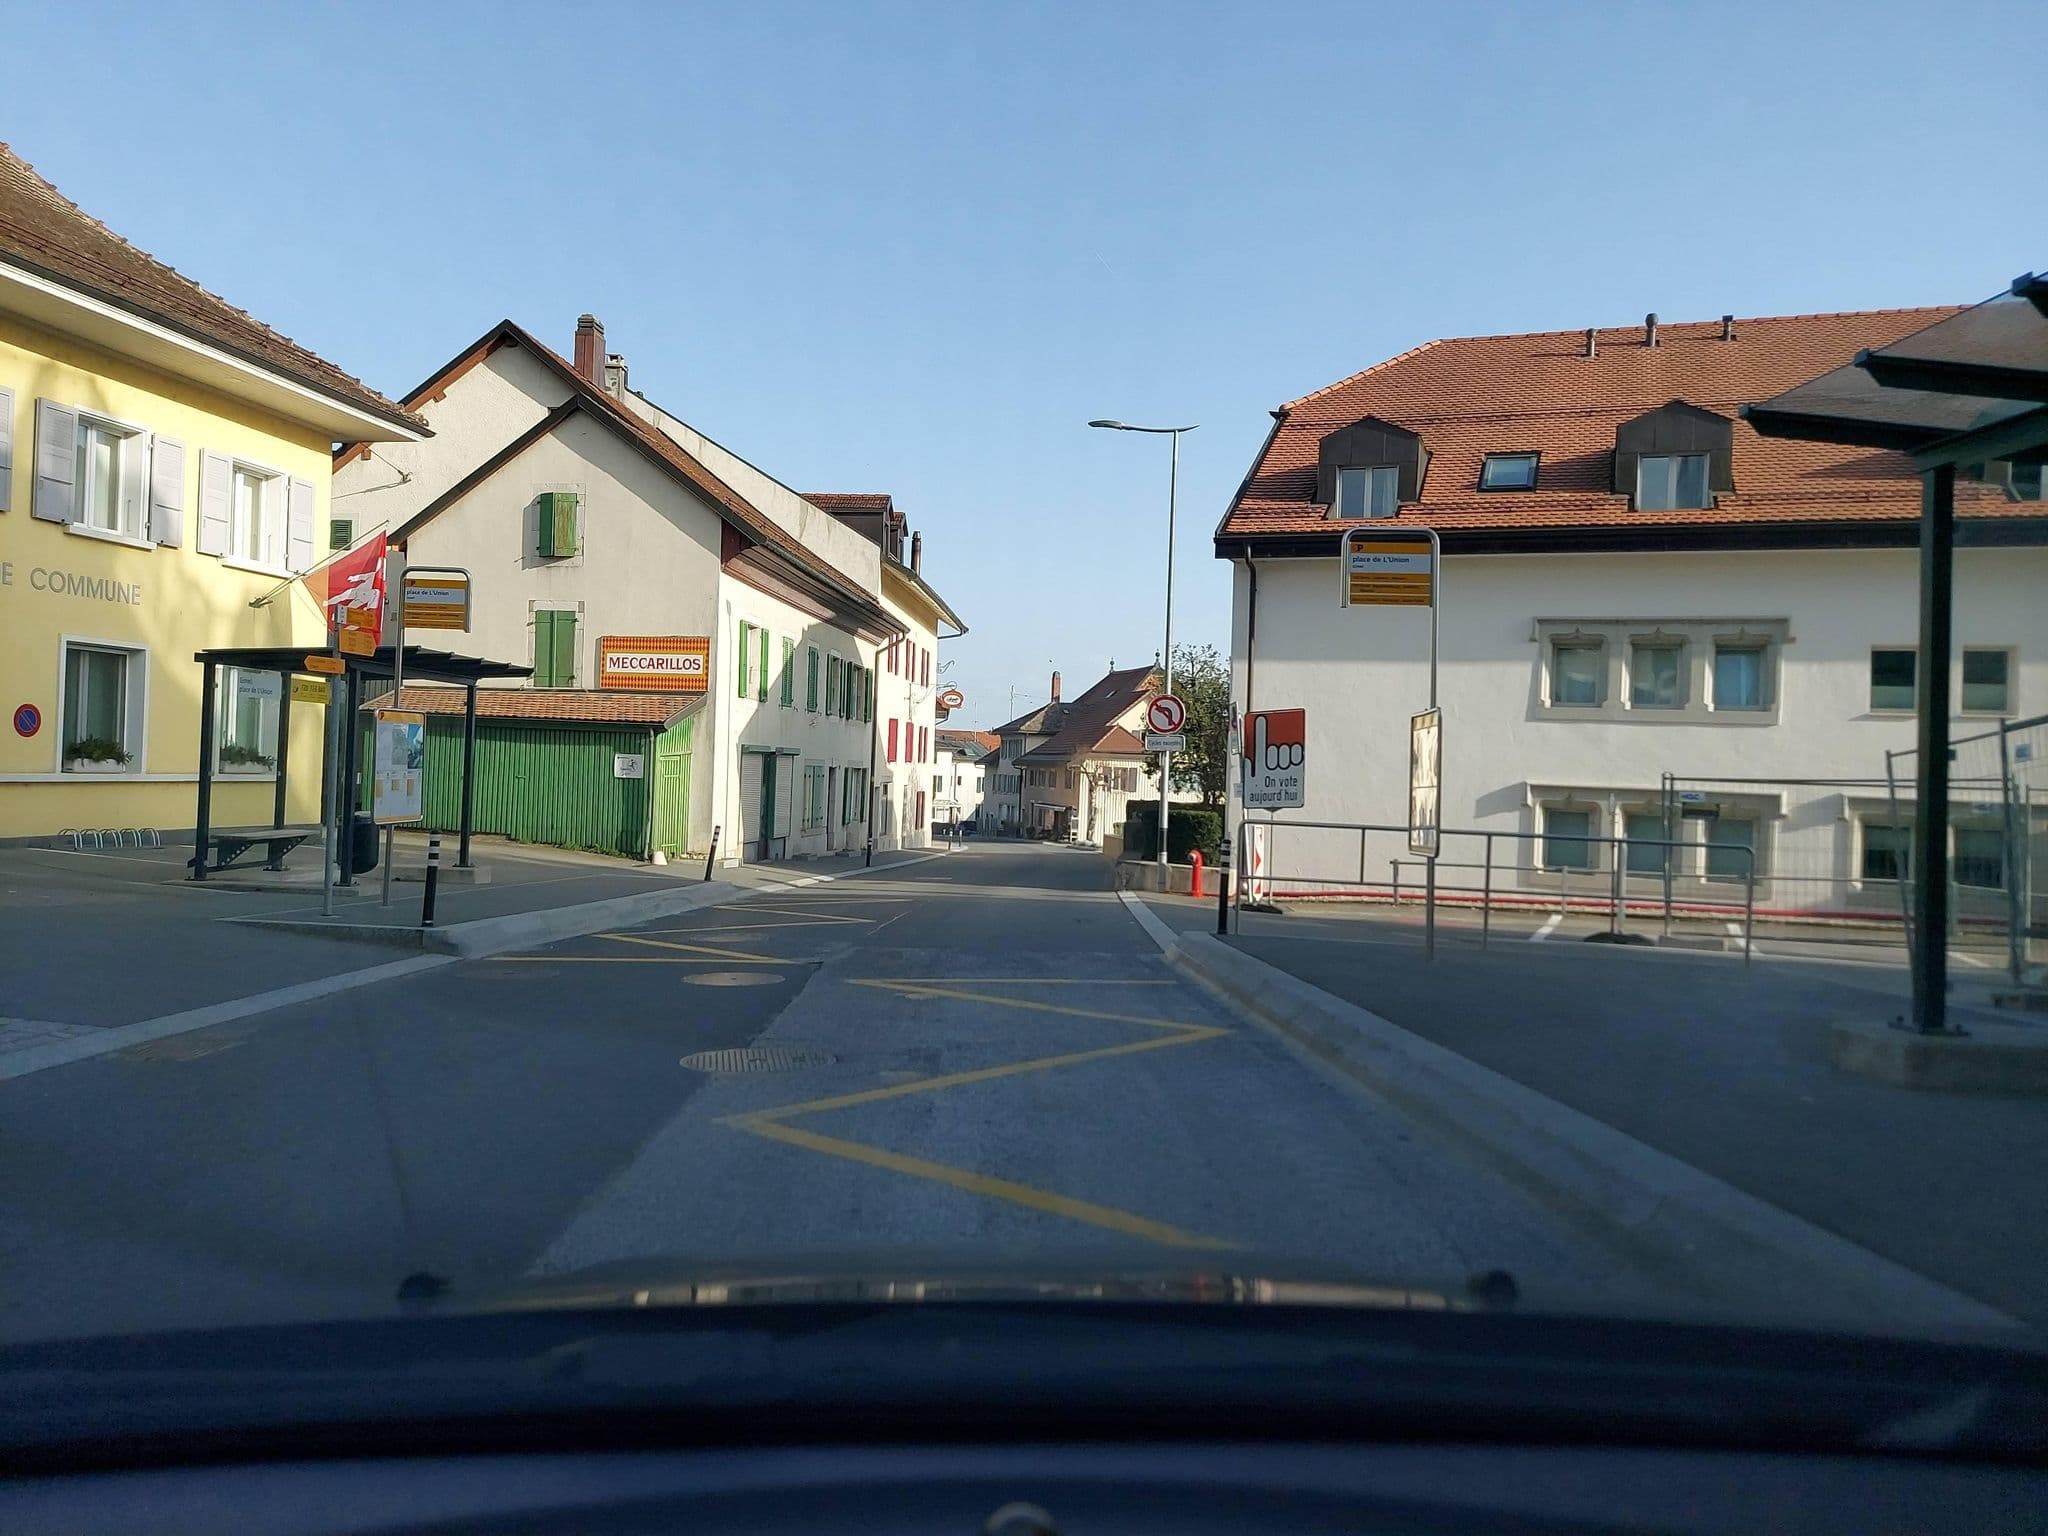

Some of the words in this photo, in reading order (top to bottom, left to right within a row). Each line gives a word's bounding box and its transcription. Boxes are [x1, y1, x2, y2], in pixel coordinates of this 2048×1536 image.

[0, 561, 13, 586] E
[30, 567, 141, 606] COMMUNE
[608, 656, 701, 671] MECCARILLOS
[1264, 775, 1276, 788] On
[1279, 775, 1298, 787] vote
